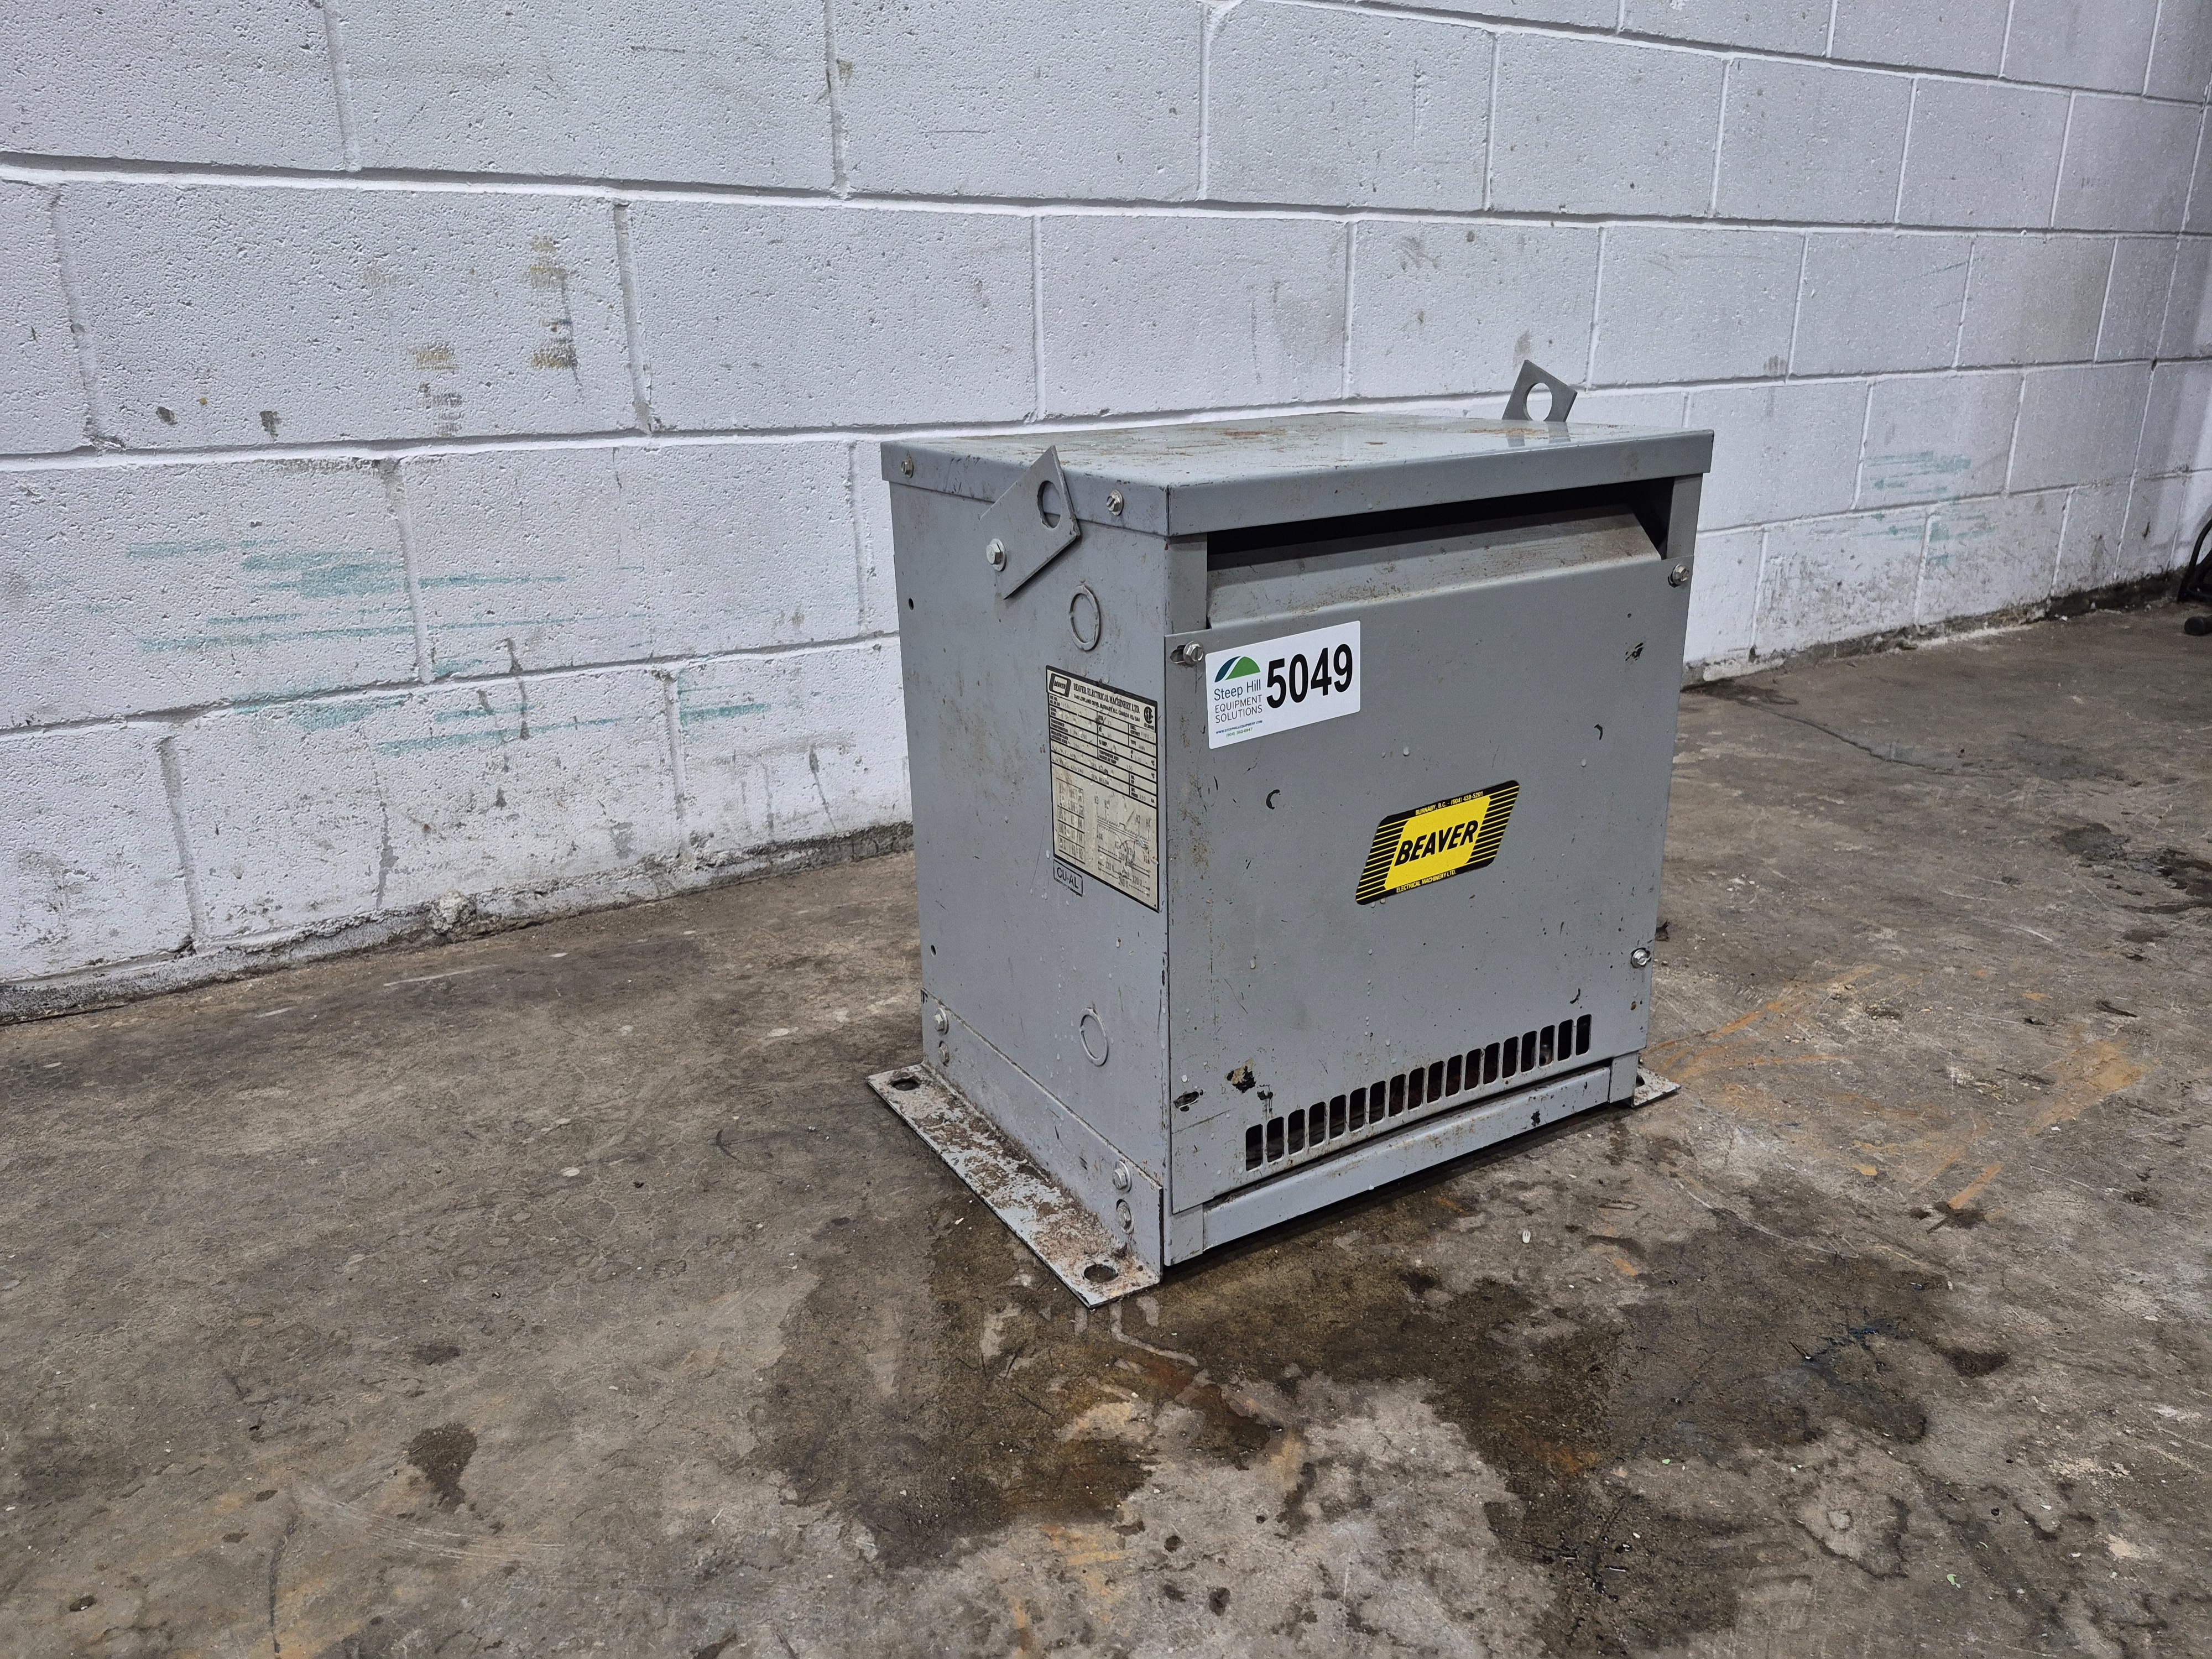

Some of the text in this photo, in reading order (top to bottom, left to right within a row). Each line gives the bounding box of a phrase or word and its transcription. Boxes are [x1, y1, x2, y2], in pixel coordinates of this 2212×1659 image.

[1266, 644, 1353, 708] 5049
[1073, 682, 1087, 695] BEAVER
[1087, 687, 1109, 702] ELECTRICAL
[1131, 703, 1140, 713] LTD.
[1214, 679, 1261, 701] Steep Hill
[1215, 695, 1262, 713] EQUIPMENT
[1215, 705, 1262, 723] SOLUTIONS
[1415, 804, 1438, 816] BURNABY,
[1451, 797, 1462, 805] (604)
[1394, 820, 1479, 867] BEAVER
[1057, 867, 1079, 889] CU-AL
[1396, 881, 1421, 893] ELECTRICAL
[1421, 873, 1447, 885] MACHINERY
